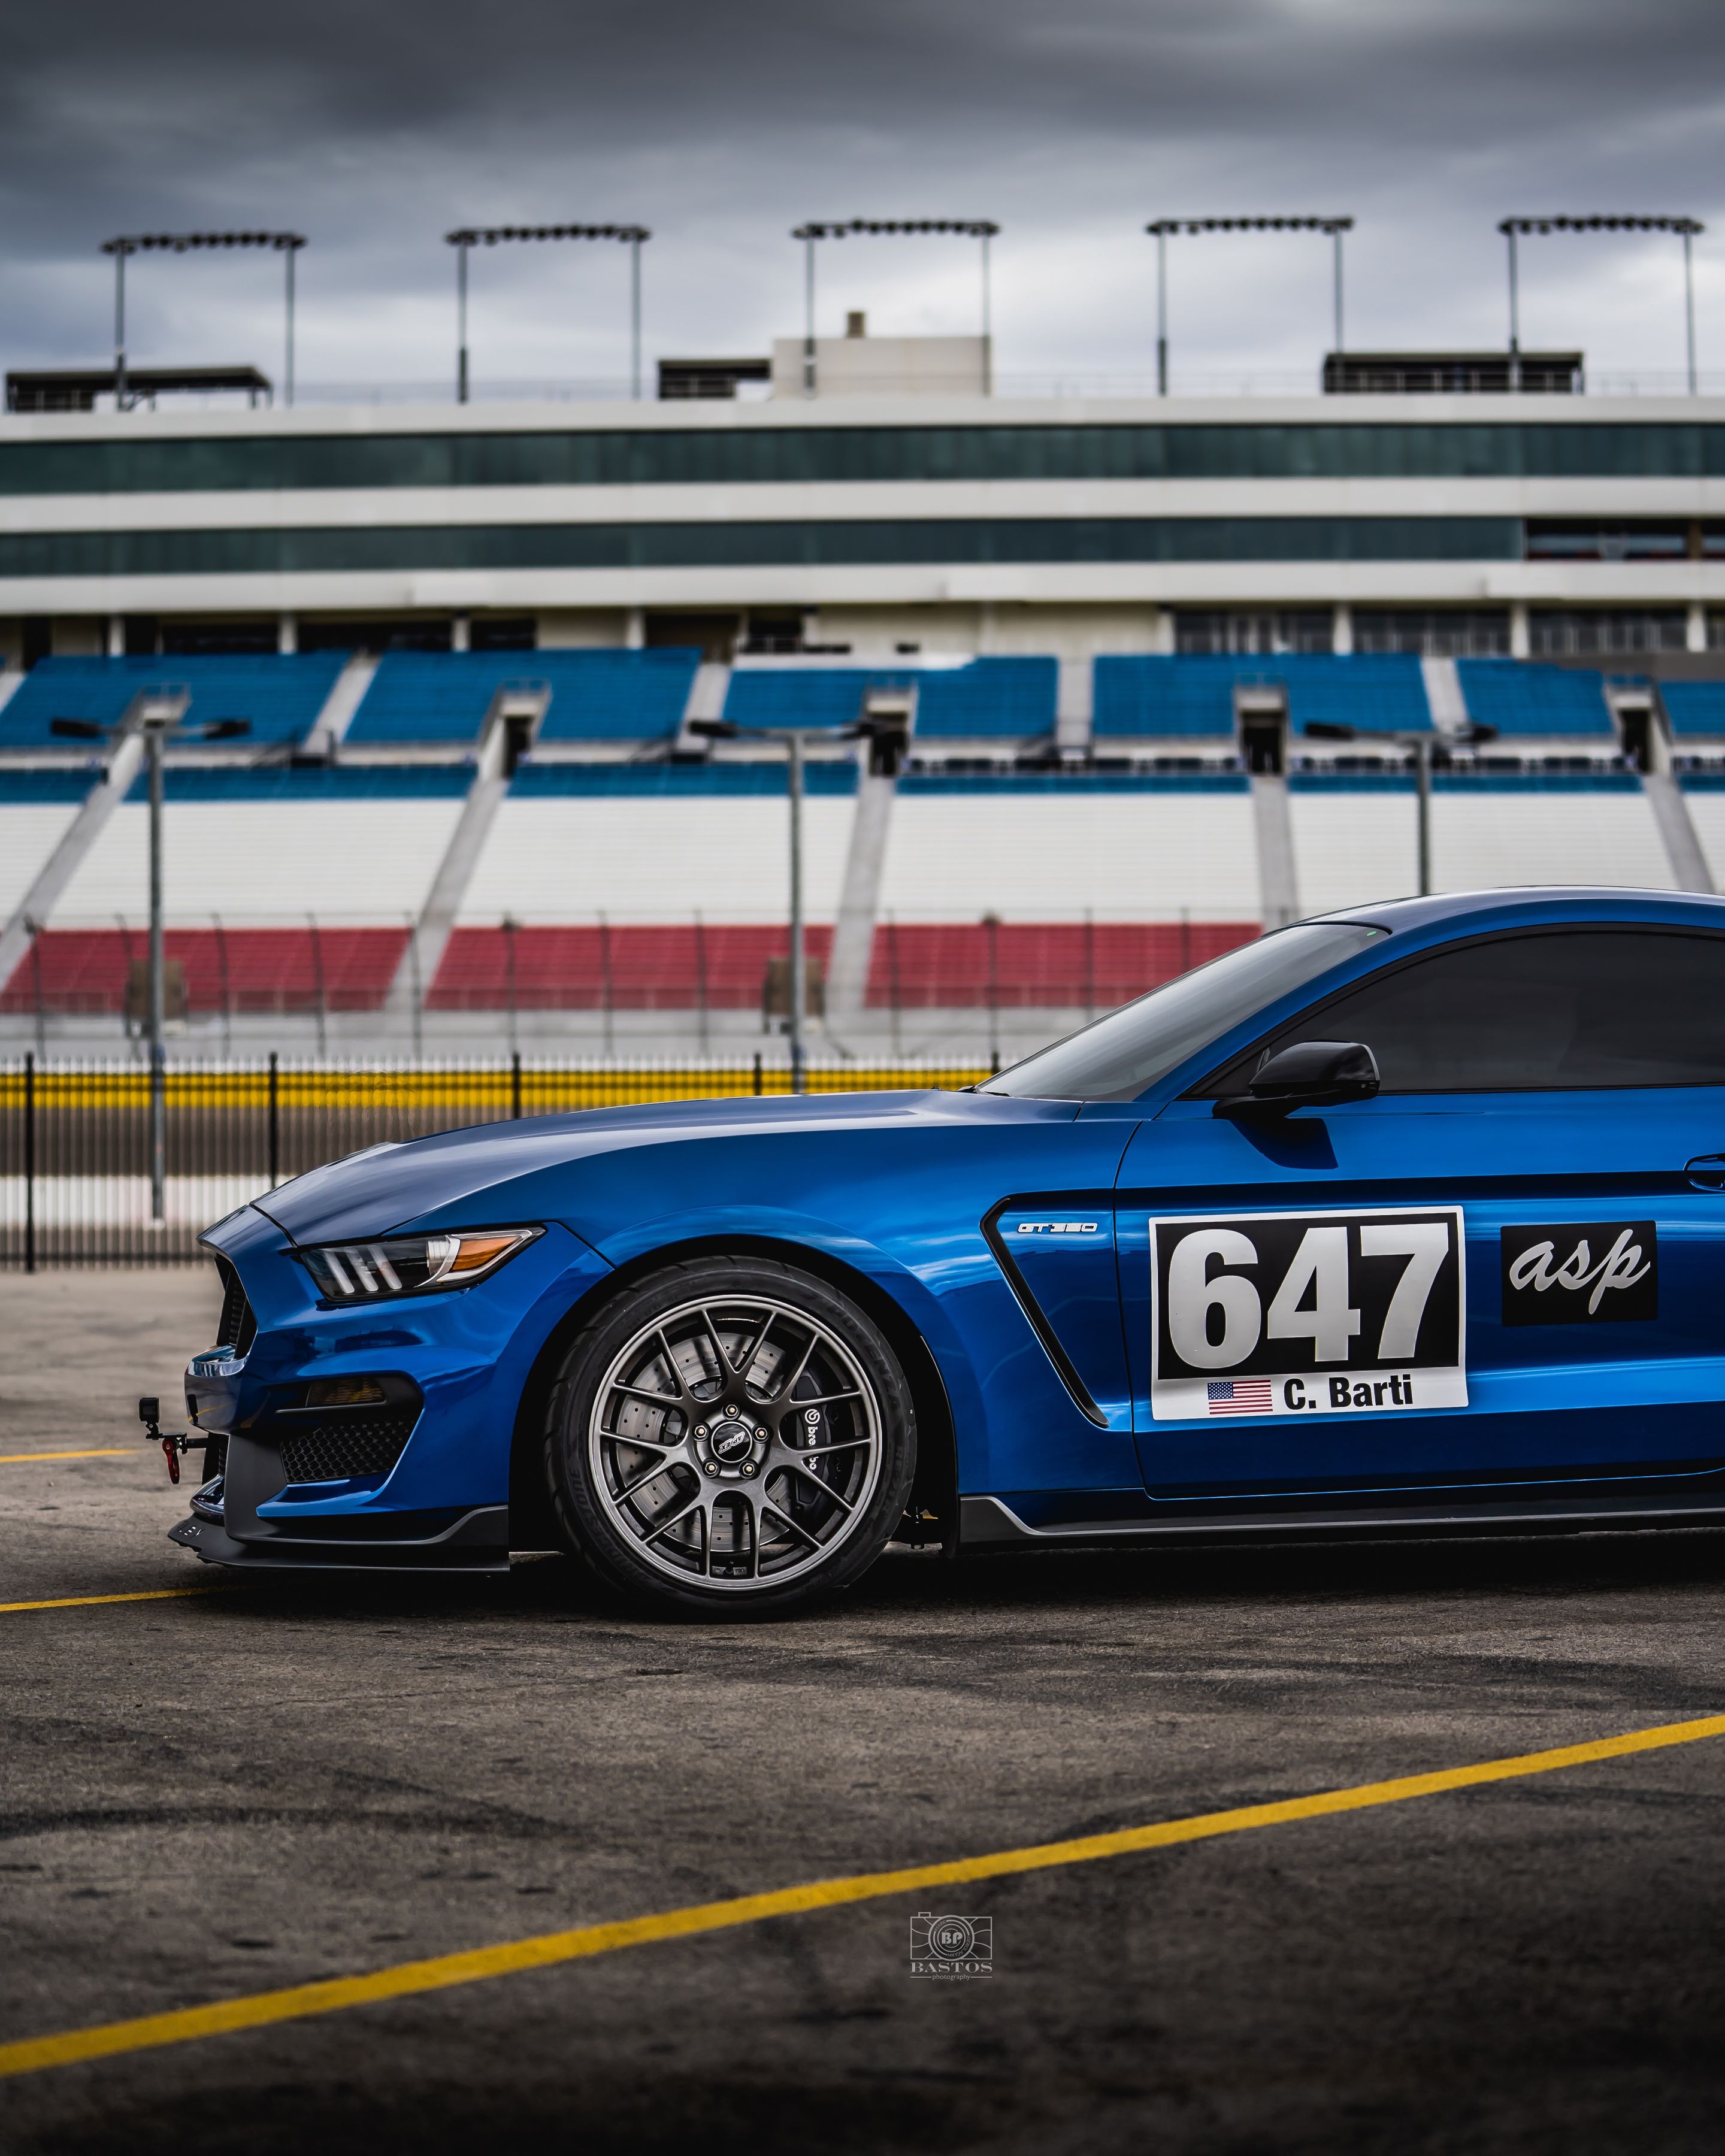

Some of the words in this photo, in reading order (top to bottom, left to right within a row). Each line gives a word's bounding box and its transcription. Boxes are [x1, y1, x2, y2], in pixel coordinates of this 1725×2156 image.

[1018, 1223, 1097, 1232] GT350
[1509, 1229, 1651, 1315] asp
[1169, 1222, 1449, 1369] 647
[1284, 1378, 1317, 1410] C.
[1329, 1374, 1414, 1408] Barti
[719, 1432, 745, 1454] APEX
[807, 1427, 819, 1470] brebo
